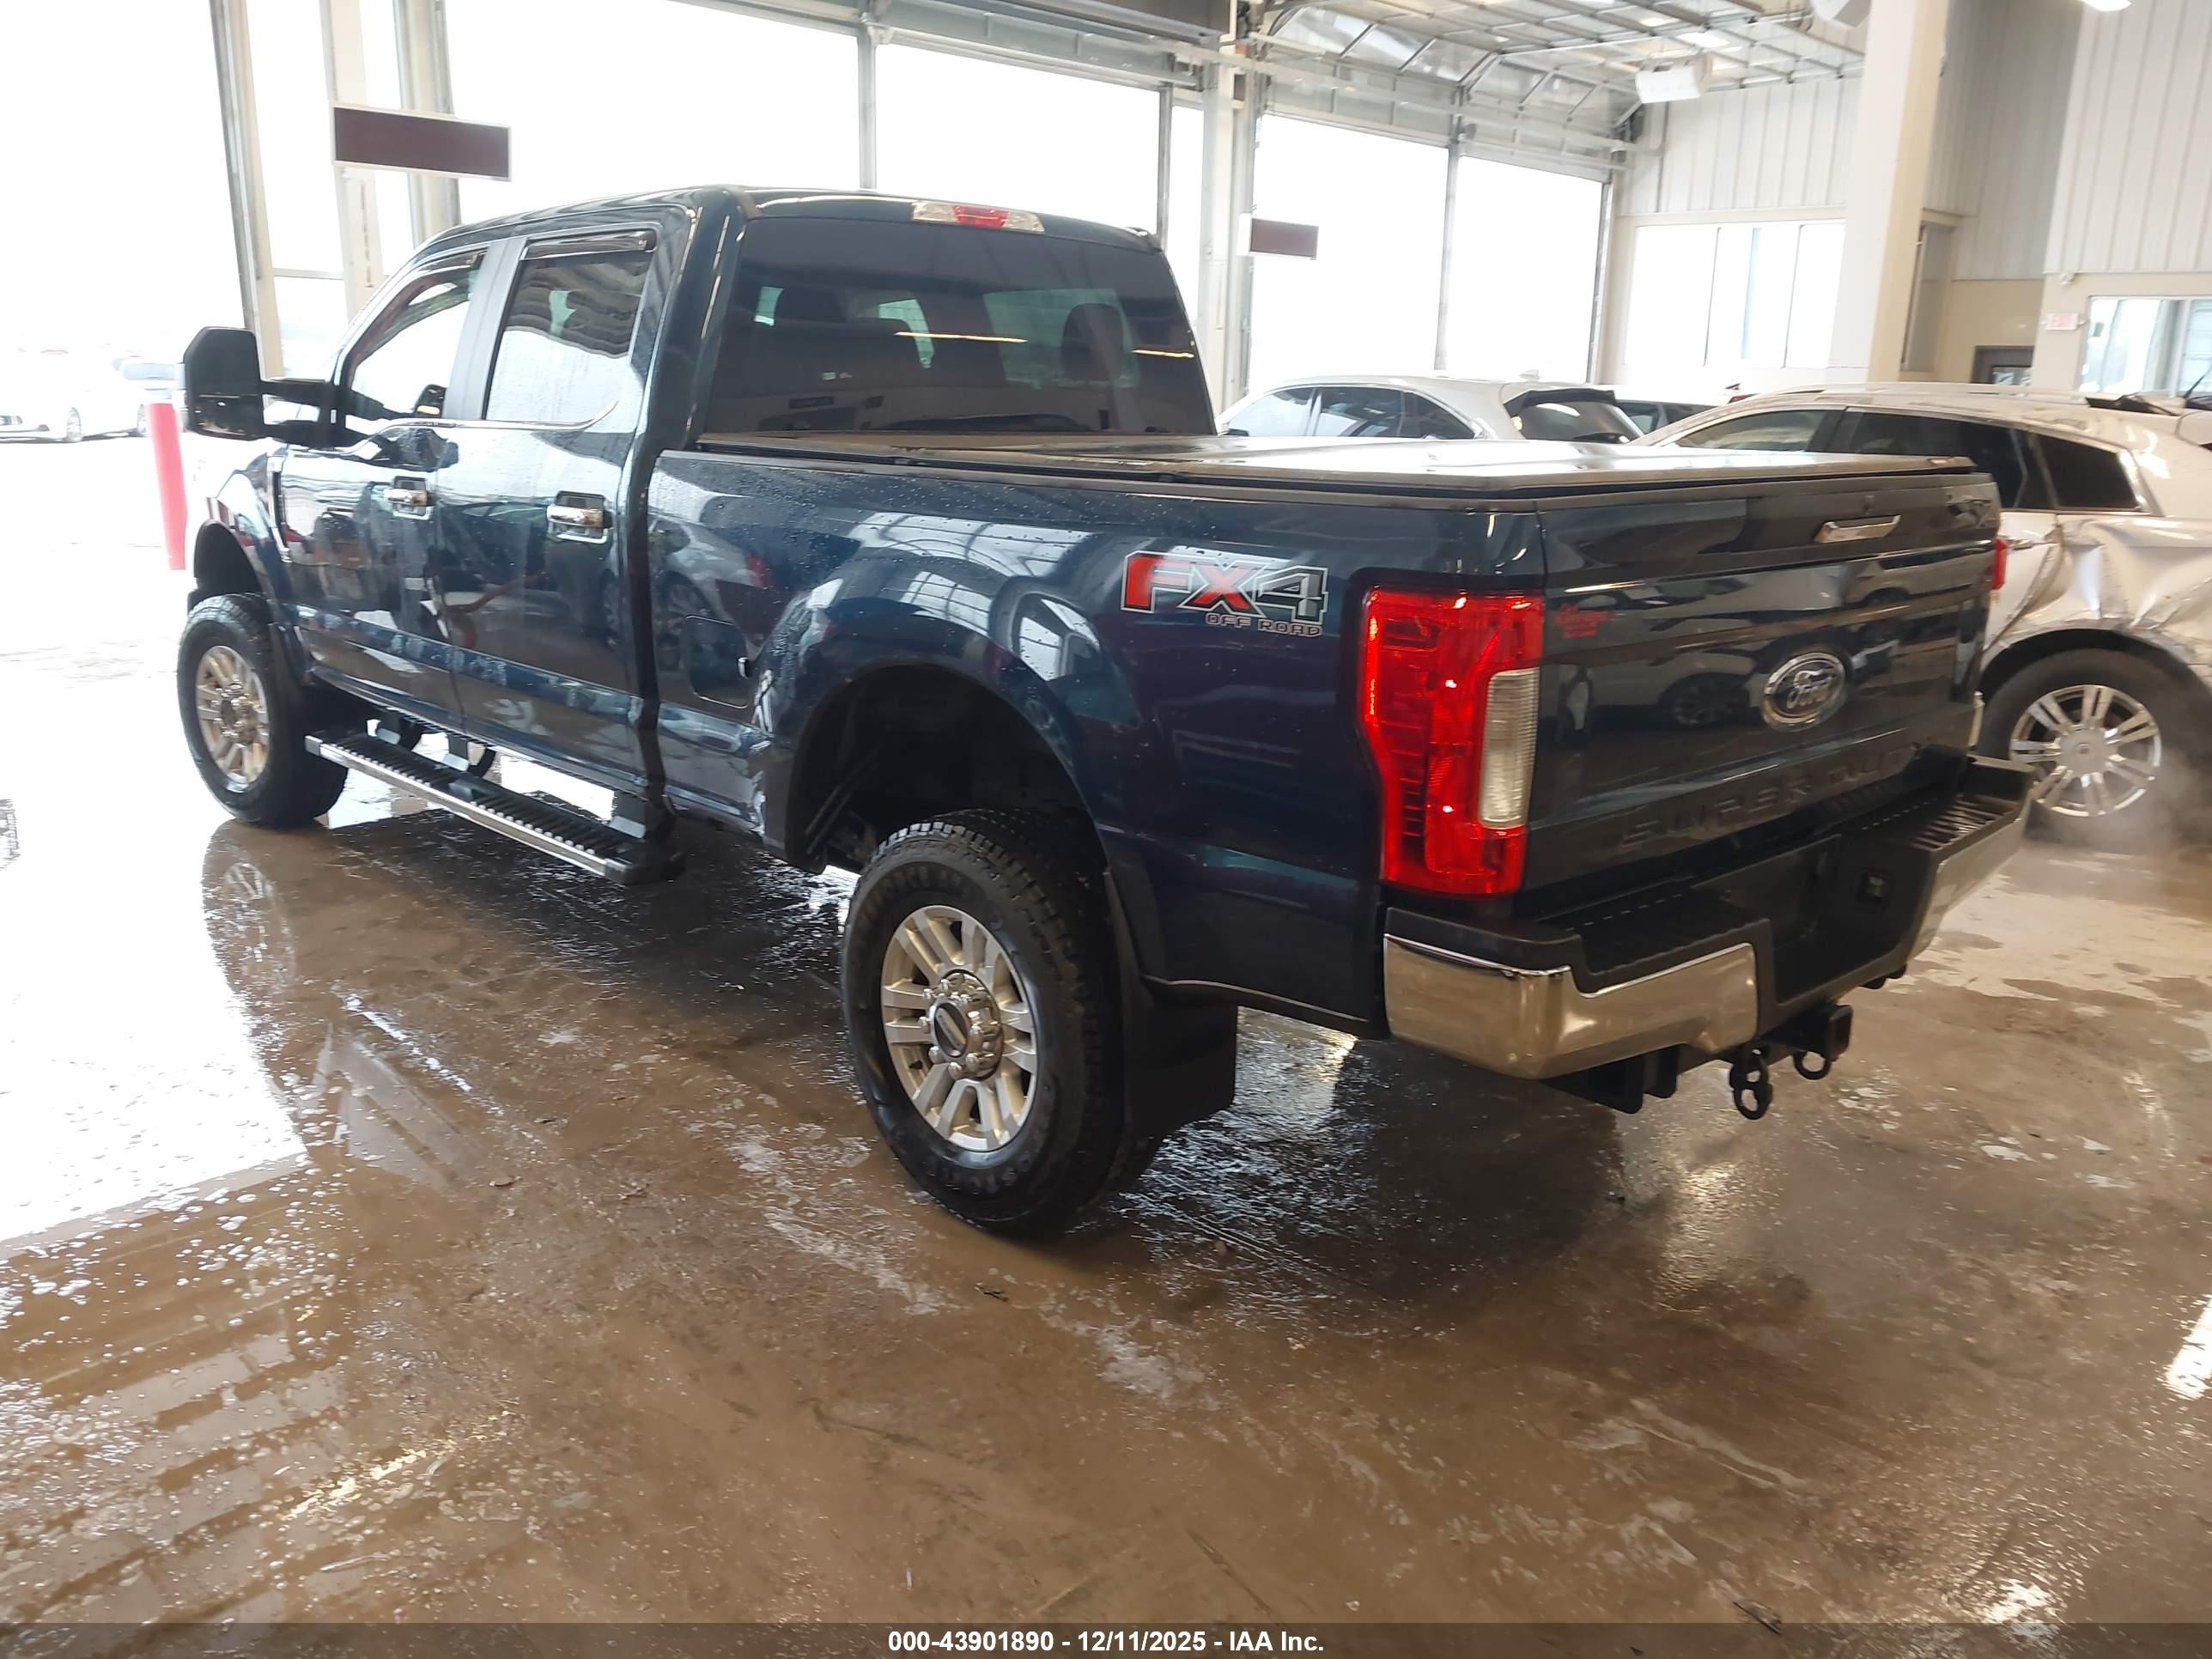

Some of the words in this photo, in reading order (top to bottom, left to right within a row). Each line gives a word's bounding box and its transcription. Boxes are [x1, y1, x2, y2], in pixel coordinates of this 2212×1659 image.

[1121, 550, 1328, 625] FX4
[1205, 612, 1252, 628] OFF
[1257, 618, 1323, 637] ROAD
